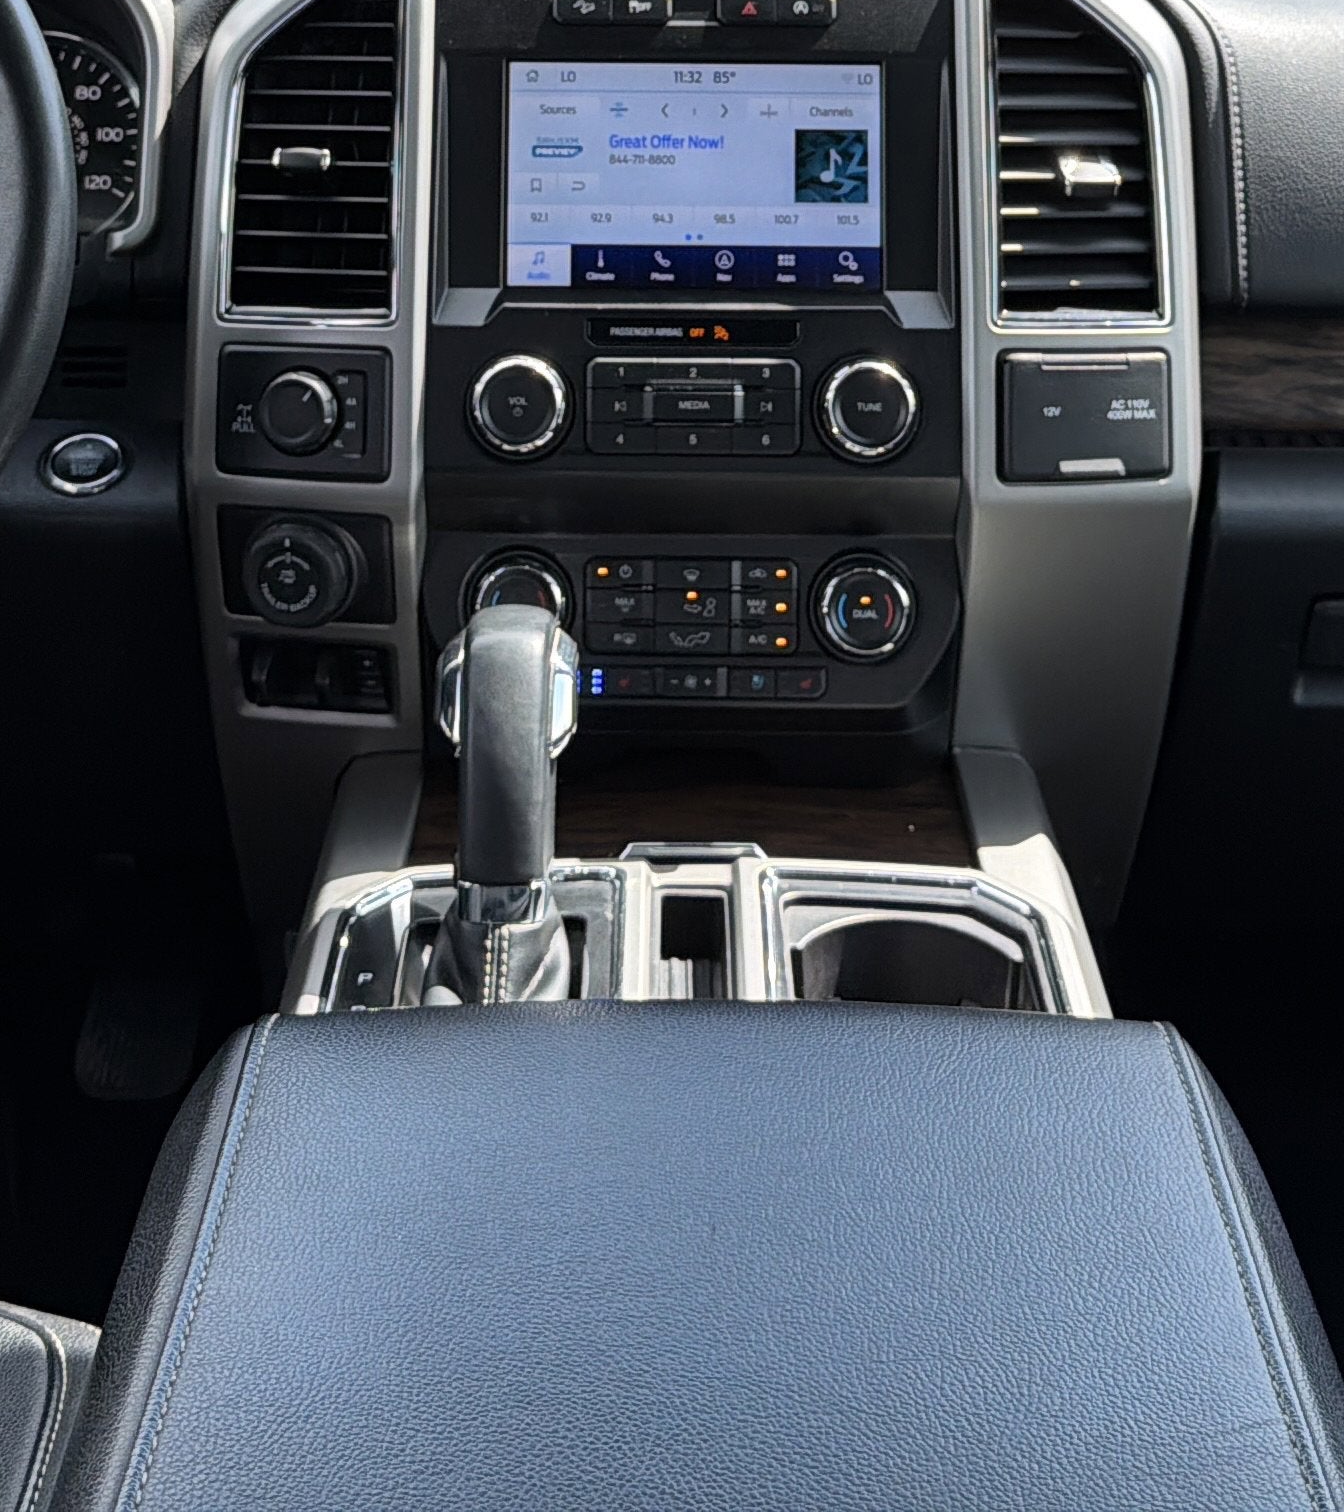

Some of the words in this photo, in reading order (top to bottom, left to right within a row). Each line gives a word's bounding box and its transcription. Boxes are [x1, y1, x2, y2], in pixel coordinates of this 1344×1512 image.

[560, 70, 577, 83] LO
[673, 70, 703, 84] 11:32
[713, 69, 736, 83] 85°
[857, 72, 874, 85] LO
[74, 85, 102, 101] 80
[540, 104, 577, 115] Sources
[809, 105, 854, 118] Channels
[95, 127, 124, 143] 100
[609, 134, 647, 149] Great
[650, 134, 684, 149] Offer
[687, 135, 724, 149] Now!
[609, 153, 676, 165] 844-711-8800
[84, 174, 112, 190] 120
[530, 211, 549, 223] 92.1
[590, 212, 612, 223] 92.9
[652, 212, 674, 224] 94.3
[713, 213, 736, 225] 98.5
[774, 213, 799, 225] 100.7
[836, 214, 860, 226] 101.5
[585, 271, 616, 281] Climate
[649, 271, 675, 282] Phone
[776, 273, 797, 284] Apps
[832, 273, 865, 285] Settings
[609, 326, 654, 337] PASSENGER
[654, 327, 683, 337] AIRBAG
[689, 327, 706, 338] OFF
[617, 366, 625, 377] 1
[688, 366, 698, 378] 2
[761, 367, 771, 378] 3
[508, 396, 528, 407] VOL
[678, 399, 711, 410] MEDIA
[857, 401, 883, 413] TUNE
[1110, 398, 1127, 410] AC
[1042, 405, 1062, 418] 12V
[1133, 408, 1157, 420] MAX
[231, 421, 256, 433] PULL
[615, 433, 625, 445] 4
[688, 433, 698, 445] 5
[761, 433, 771, 445] 6
[852, 608, 879, 619] DUAL
[748, 634, 768, 645] A/C
[357, 972, 374, 987] P
